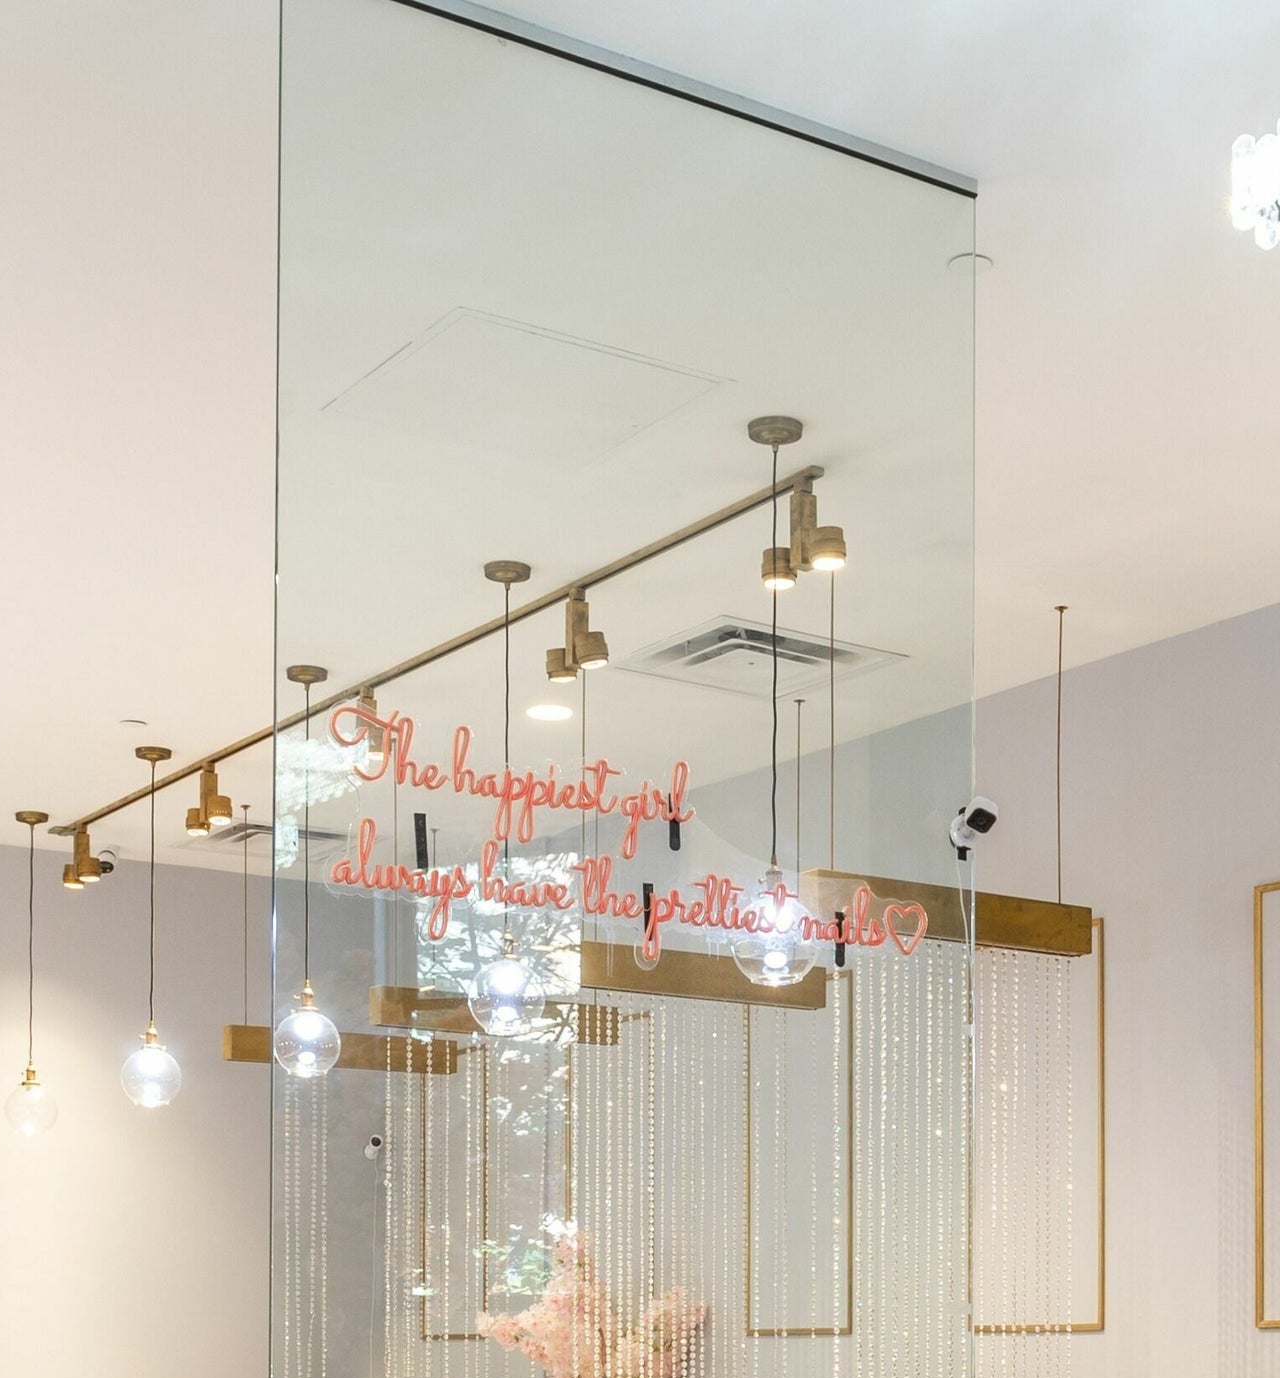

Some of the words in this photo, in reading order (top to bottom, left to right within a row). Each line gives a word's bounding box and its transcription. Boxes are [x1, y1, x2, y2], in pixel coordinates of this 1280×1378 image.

[331, 706, 449, 790] The
[453, 725, 621, 843] happiest
[620, 760, 696, 859] girl
[331, 818, 473, 940] always
[481, 840, 574, 910] have
[571, 855, 644, 918] the
[643, 873, 799, 960] prettiest
[800, 886, 887, 947] nails
